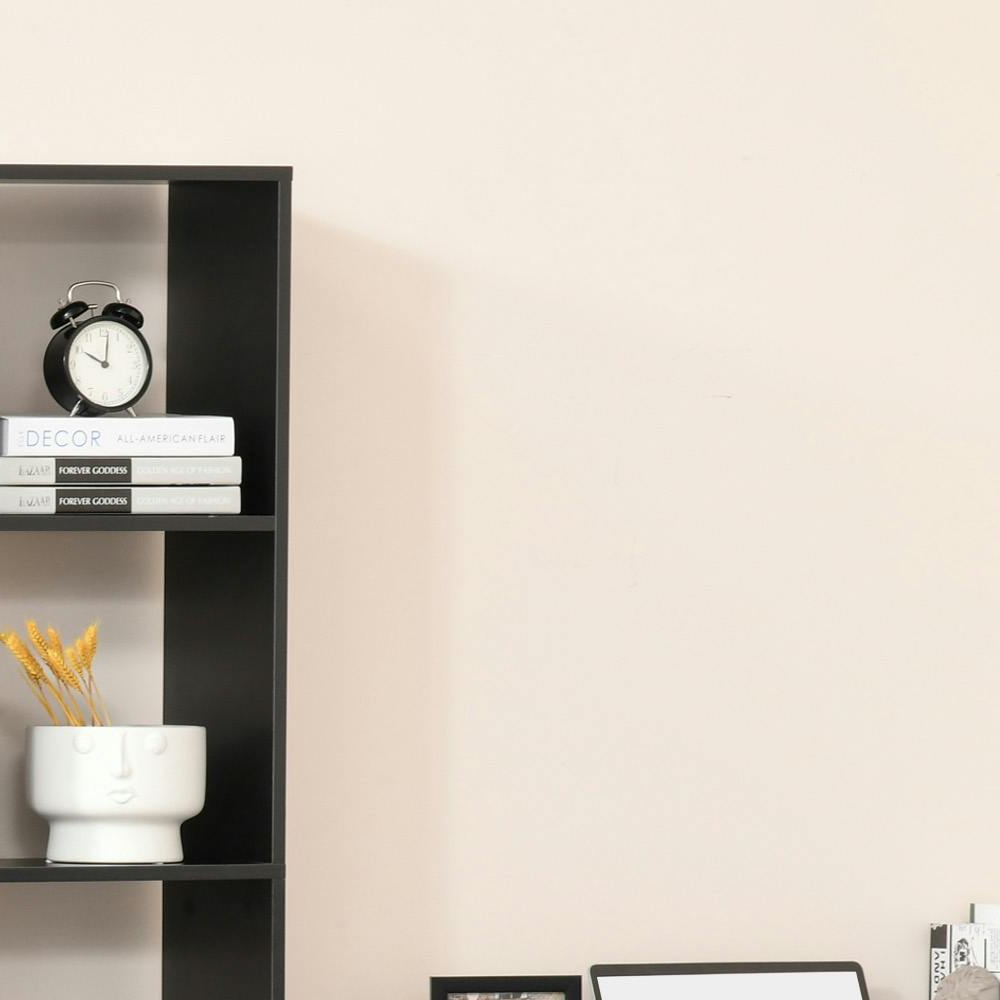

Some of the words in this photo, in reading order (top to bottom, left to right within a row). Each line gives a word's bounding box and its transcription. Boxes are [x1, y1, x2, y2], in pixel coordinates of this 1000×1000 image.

[26, 430, 101, 447] DECOR
[59, 466, 91, 475] FOREVER
[92, 466, 128, 475] GODDESS
[59, 497, 91, 506] FOREVER
[92, 497, 128, 506] GODDESS
